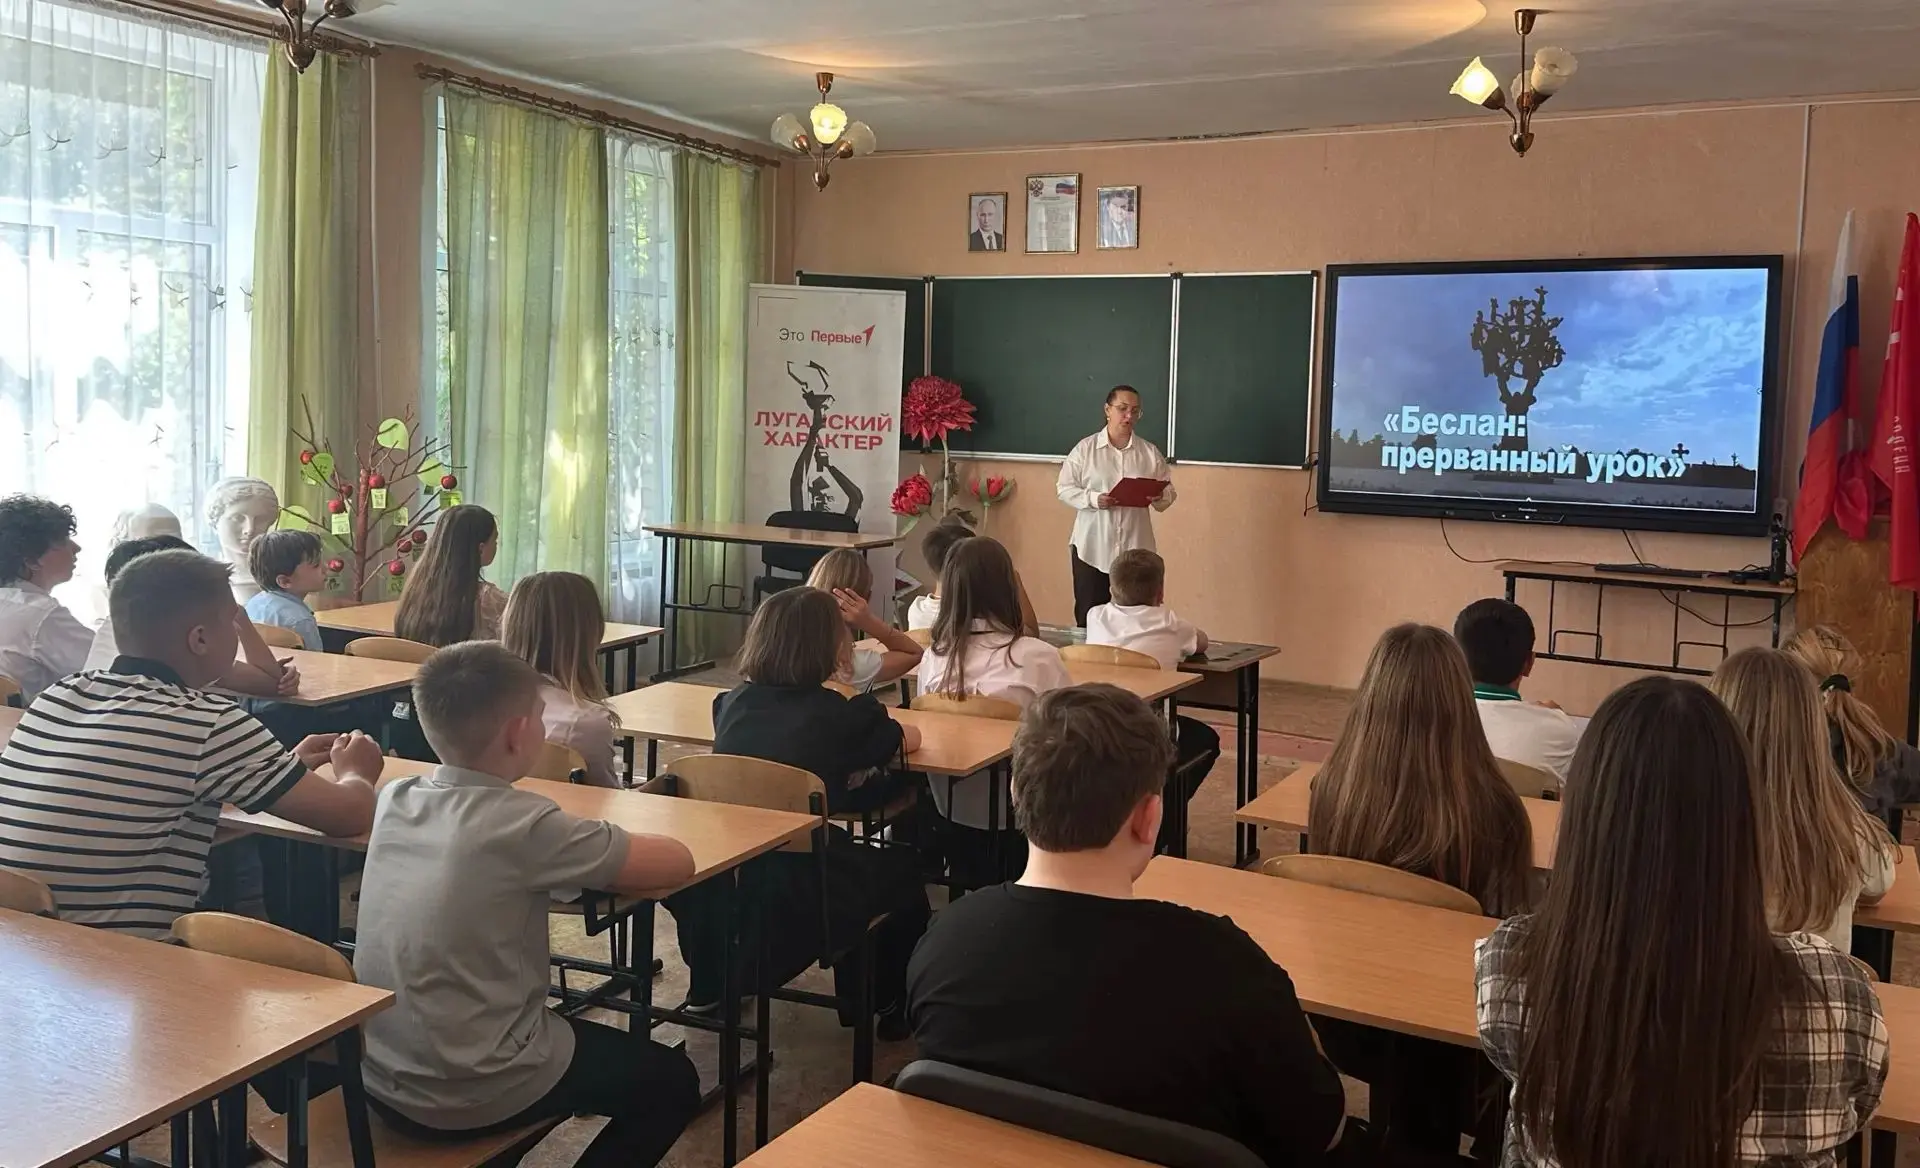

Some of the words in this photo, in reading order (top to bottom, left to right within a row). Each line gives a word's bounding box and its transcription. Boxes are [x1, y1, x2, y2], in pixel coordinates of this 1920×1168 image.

[779, 327, 805, 342] Это
[811, 330, 862, 345] Первые
[754, 411, 892, 433] ЛУГАСКИЙ
[1383, 405, 1527, 438] «Беслан:
[1381, 444, 1577, 476] прерванный
[1586, 451, 1687, 484] урок»
